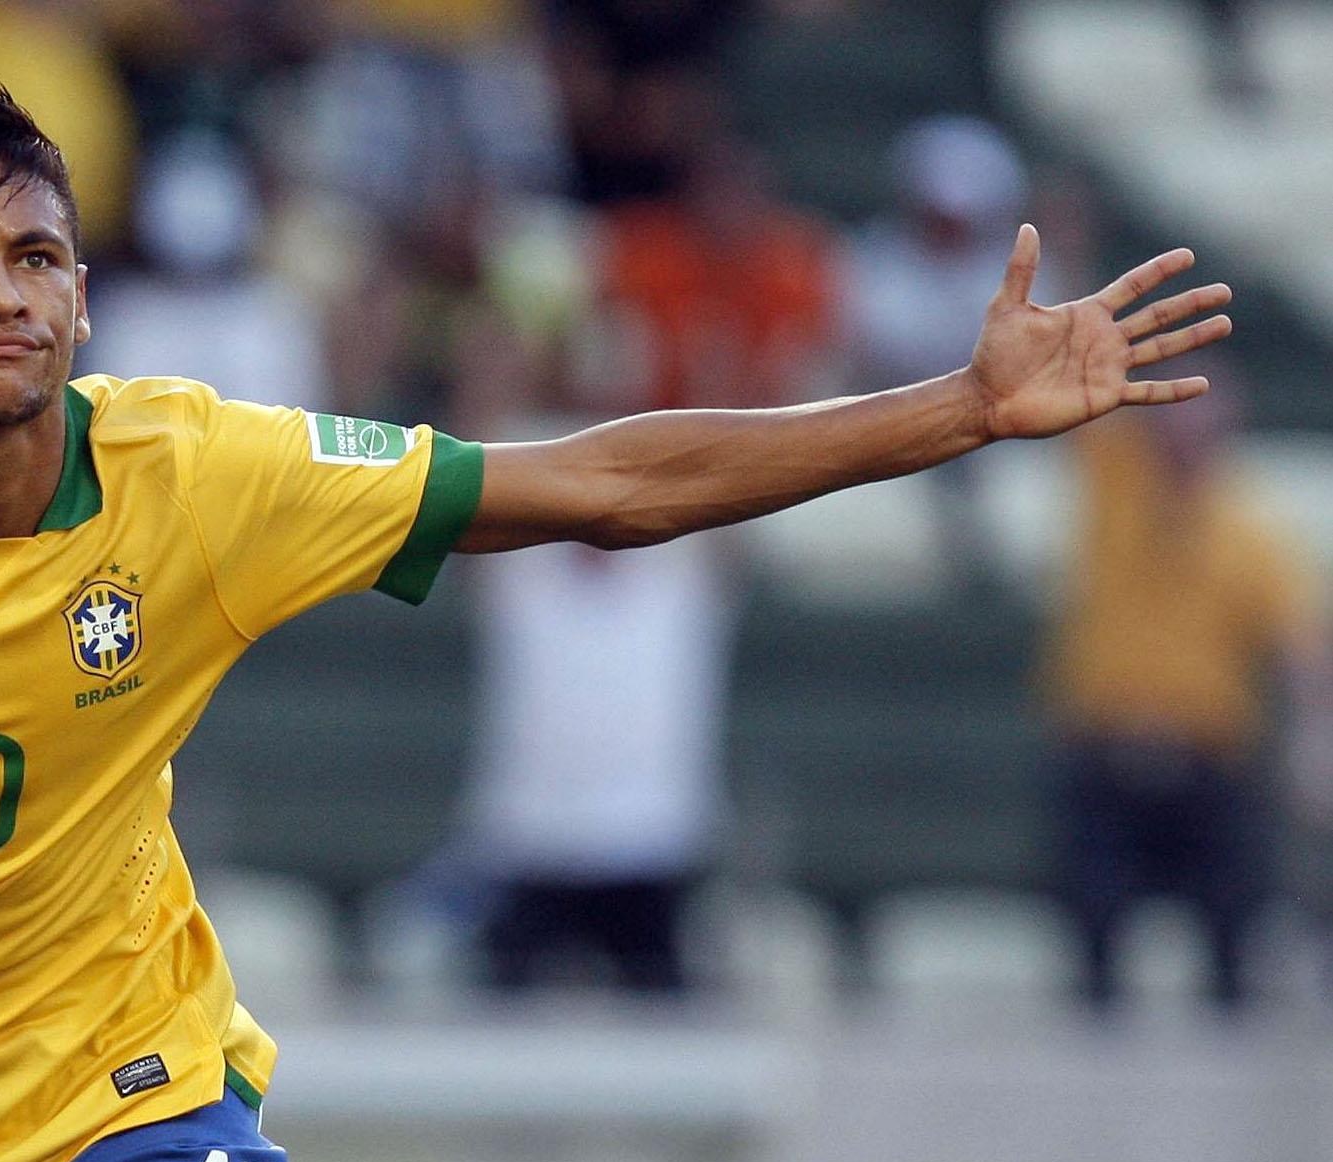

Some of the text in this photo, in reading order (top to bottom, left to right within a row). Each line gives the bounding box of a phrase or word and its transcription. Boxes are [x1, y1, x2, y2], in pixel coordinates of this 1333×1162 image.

[347, 436, 358, 456] FOR
[92, 620, 118, 635] CBF
[75, 675, 143, 709] BRASIL
[115, 1056, 159, 1077] AUTHENTIC
